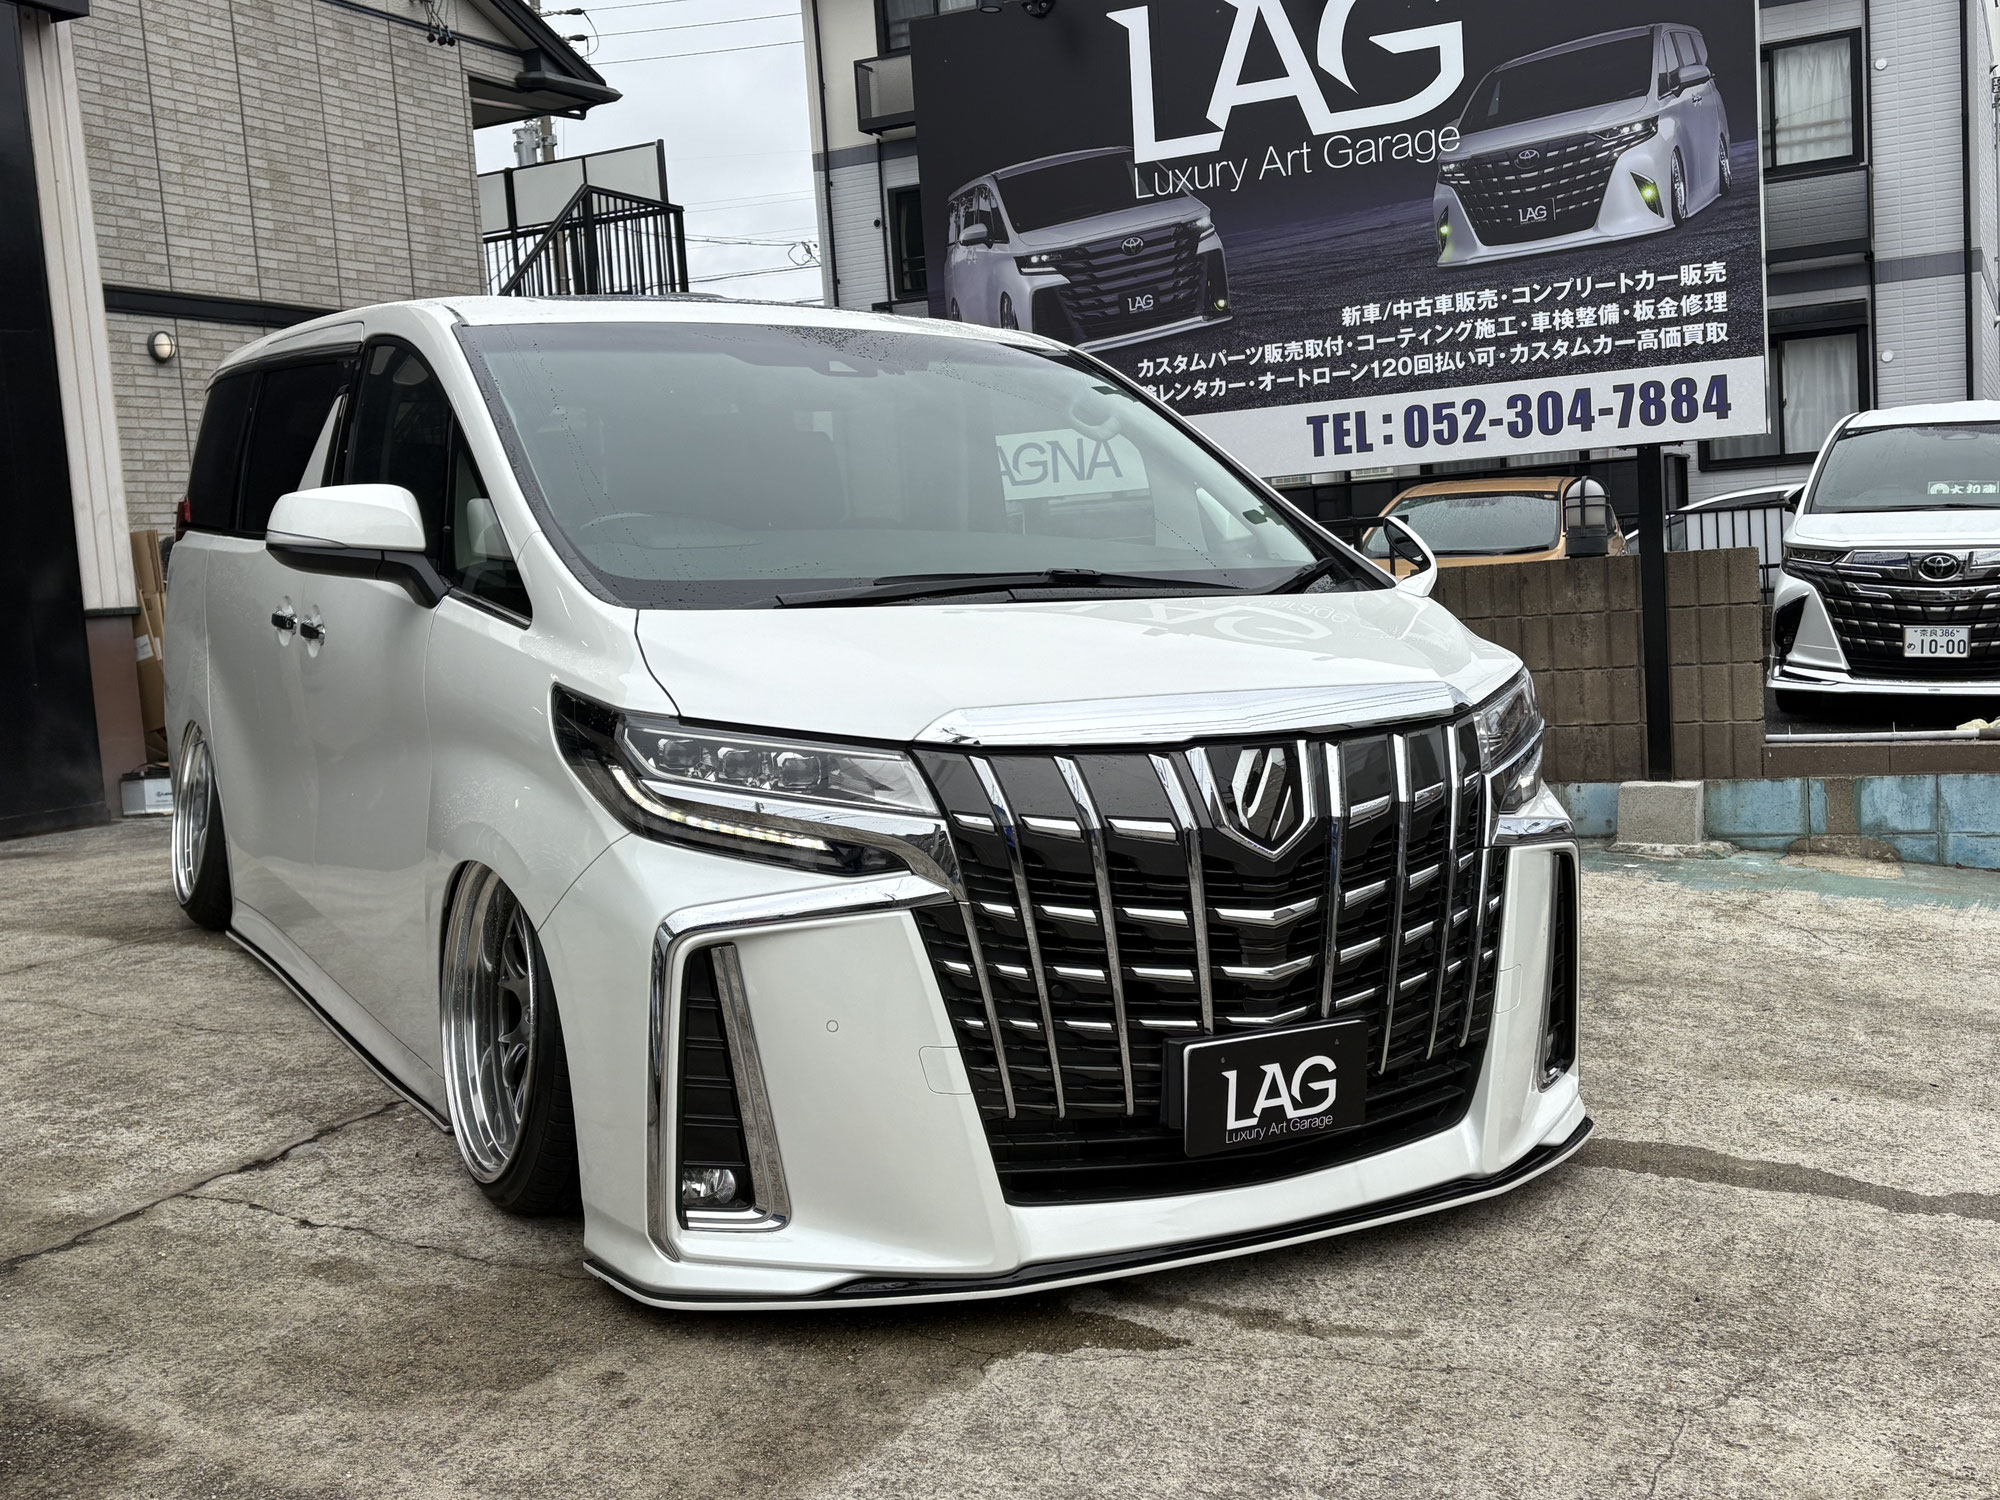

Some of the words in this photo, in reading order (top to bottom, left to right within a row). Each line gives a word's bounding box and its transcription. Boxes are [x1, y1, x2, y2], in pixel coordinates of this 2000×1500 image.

[1106, 0, 1465, 164] LAG
[1134, 158, 1248, 199] Luxury
[1259, 141, 1313, 180] Art
[1324, 126, 1461, 169] Garage
[1518, 206, 1547, 222] LAG
[1128, 294, 1154, 311] LAG
[1341, 261, 1727, 327] 新車/中古車販売・コンプリートカー販売
[1906, 642, 1916, 651] め
[1920, 638, 1967, 655] 10-00
[1221, 1055, 1337, 1130] LAG
[1225, 1127, 1266, 1144] Luxury
[1268, 1119, 1287, 1136] Art
[1290, 1114, 1333, 1132] Garage
